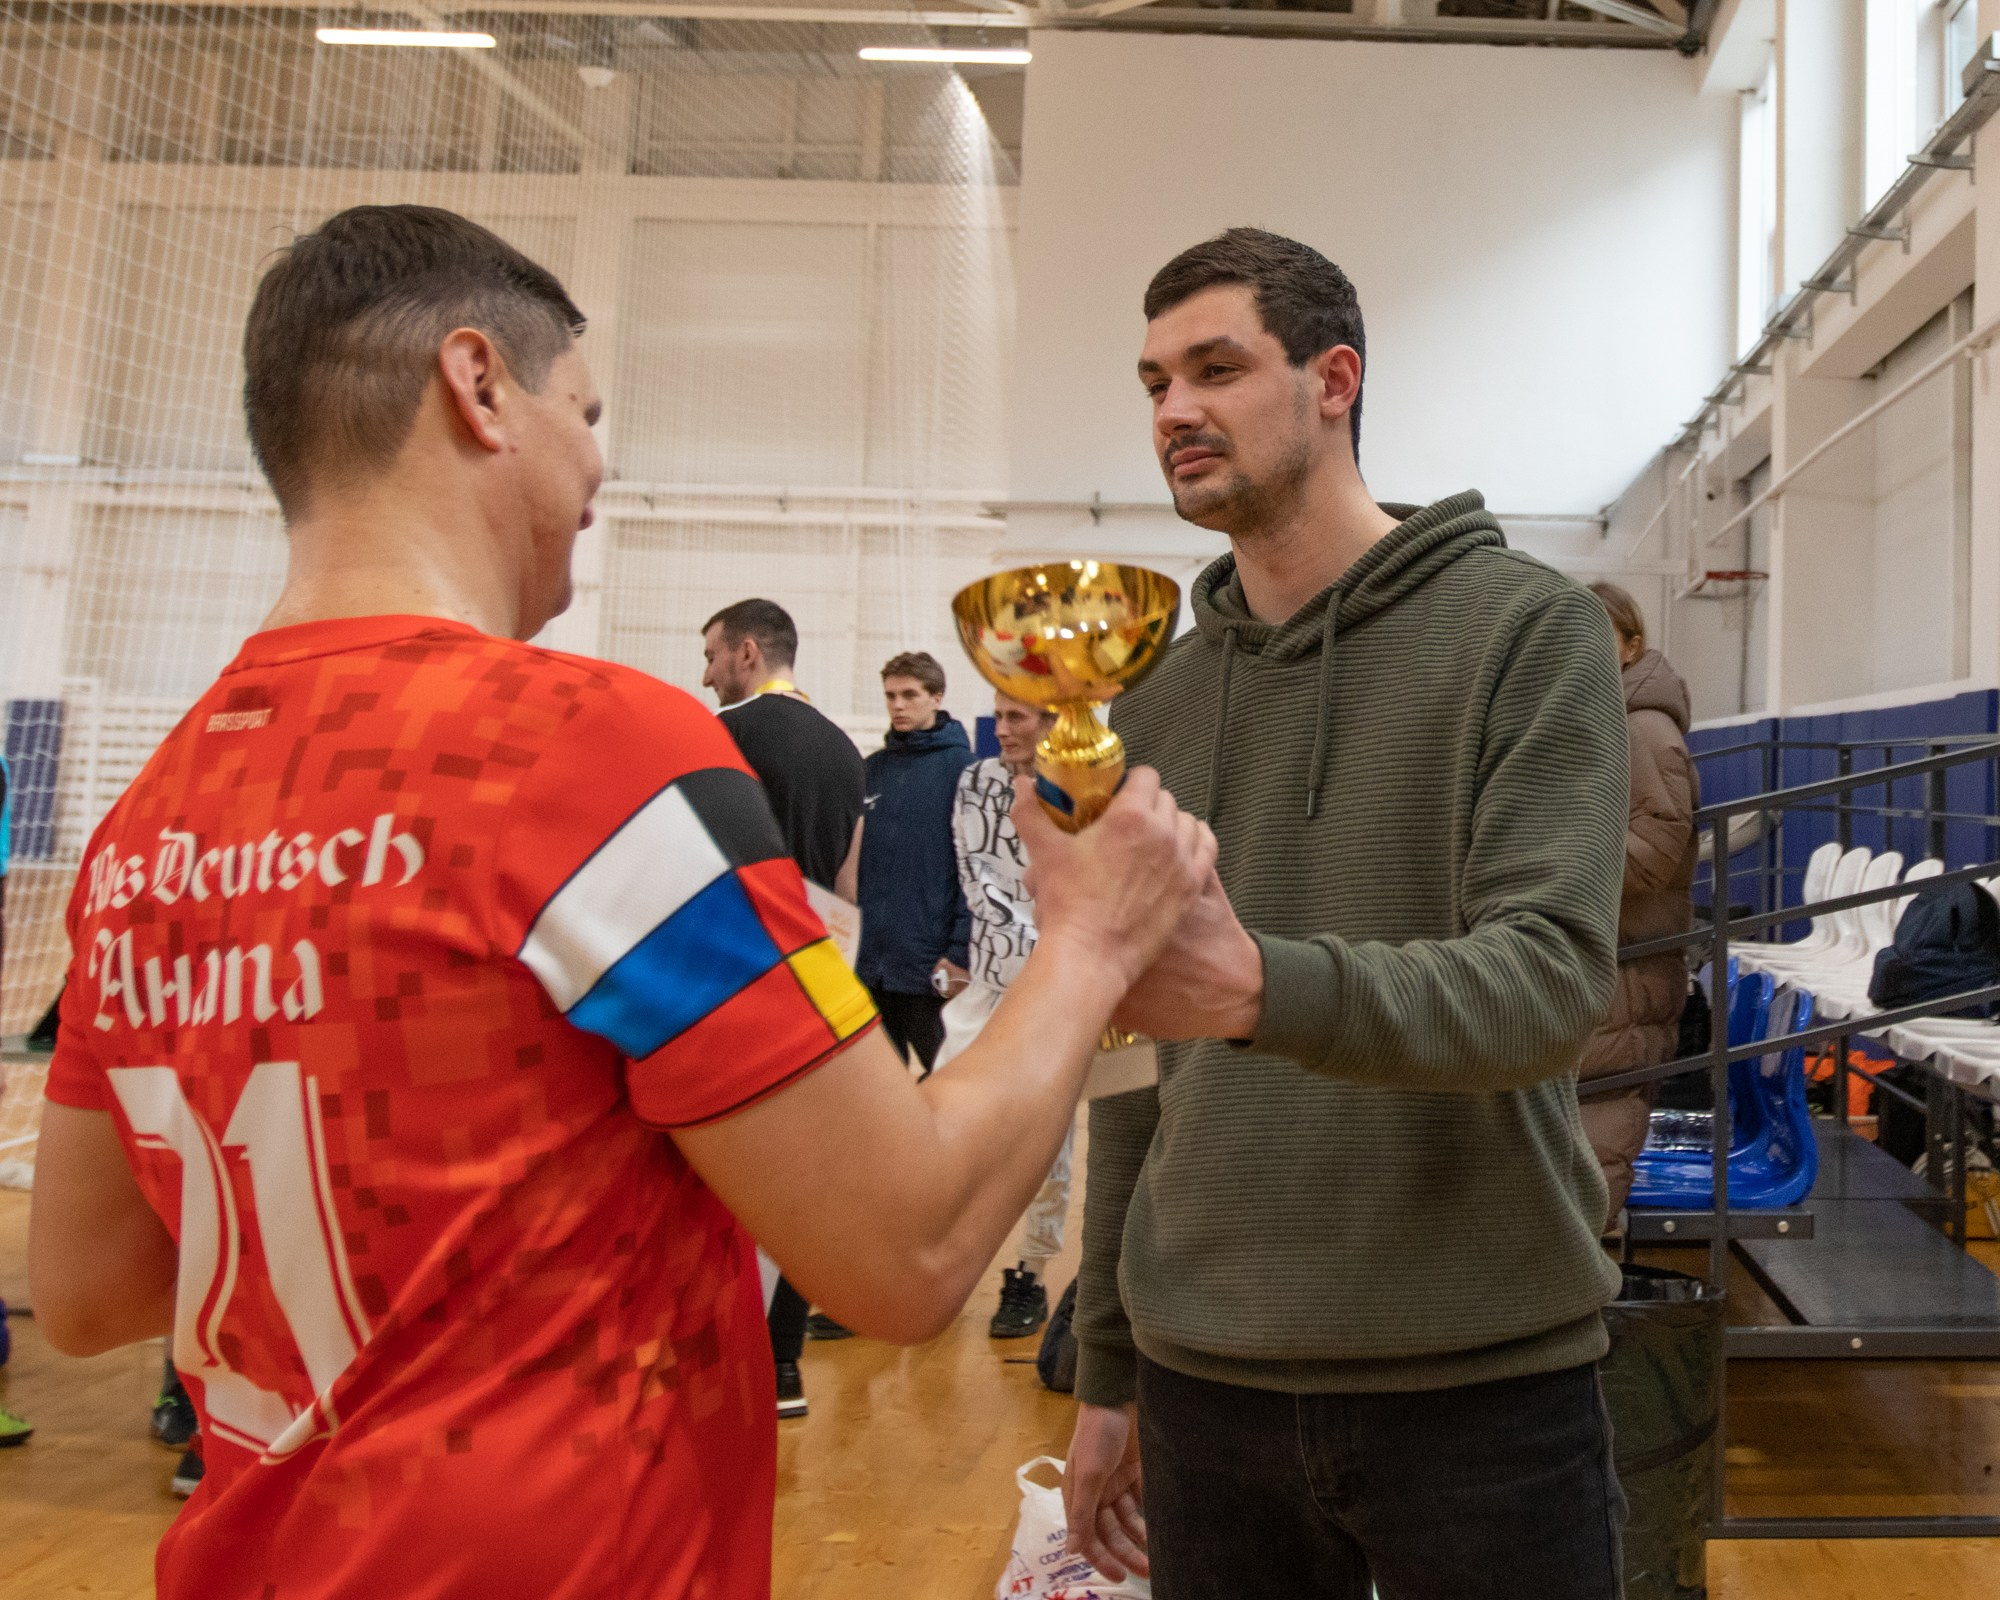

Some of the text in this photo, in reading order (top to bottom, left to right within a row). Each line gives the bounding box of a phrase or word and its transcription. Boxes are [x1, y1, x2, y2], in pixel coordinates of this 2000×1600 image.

[151, 812, 426, 906] Deutsch
[87, 926, 325, 1033] Анапа
[105, 1060, 372, 1467] 21
